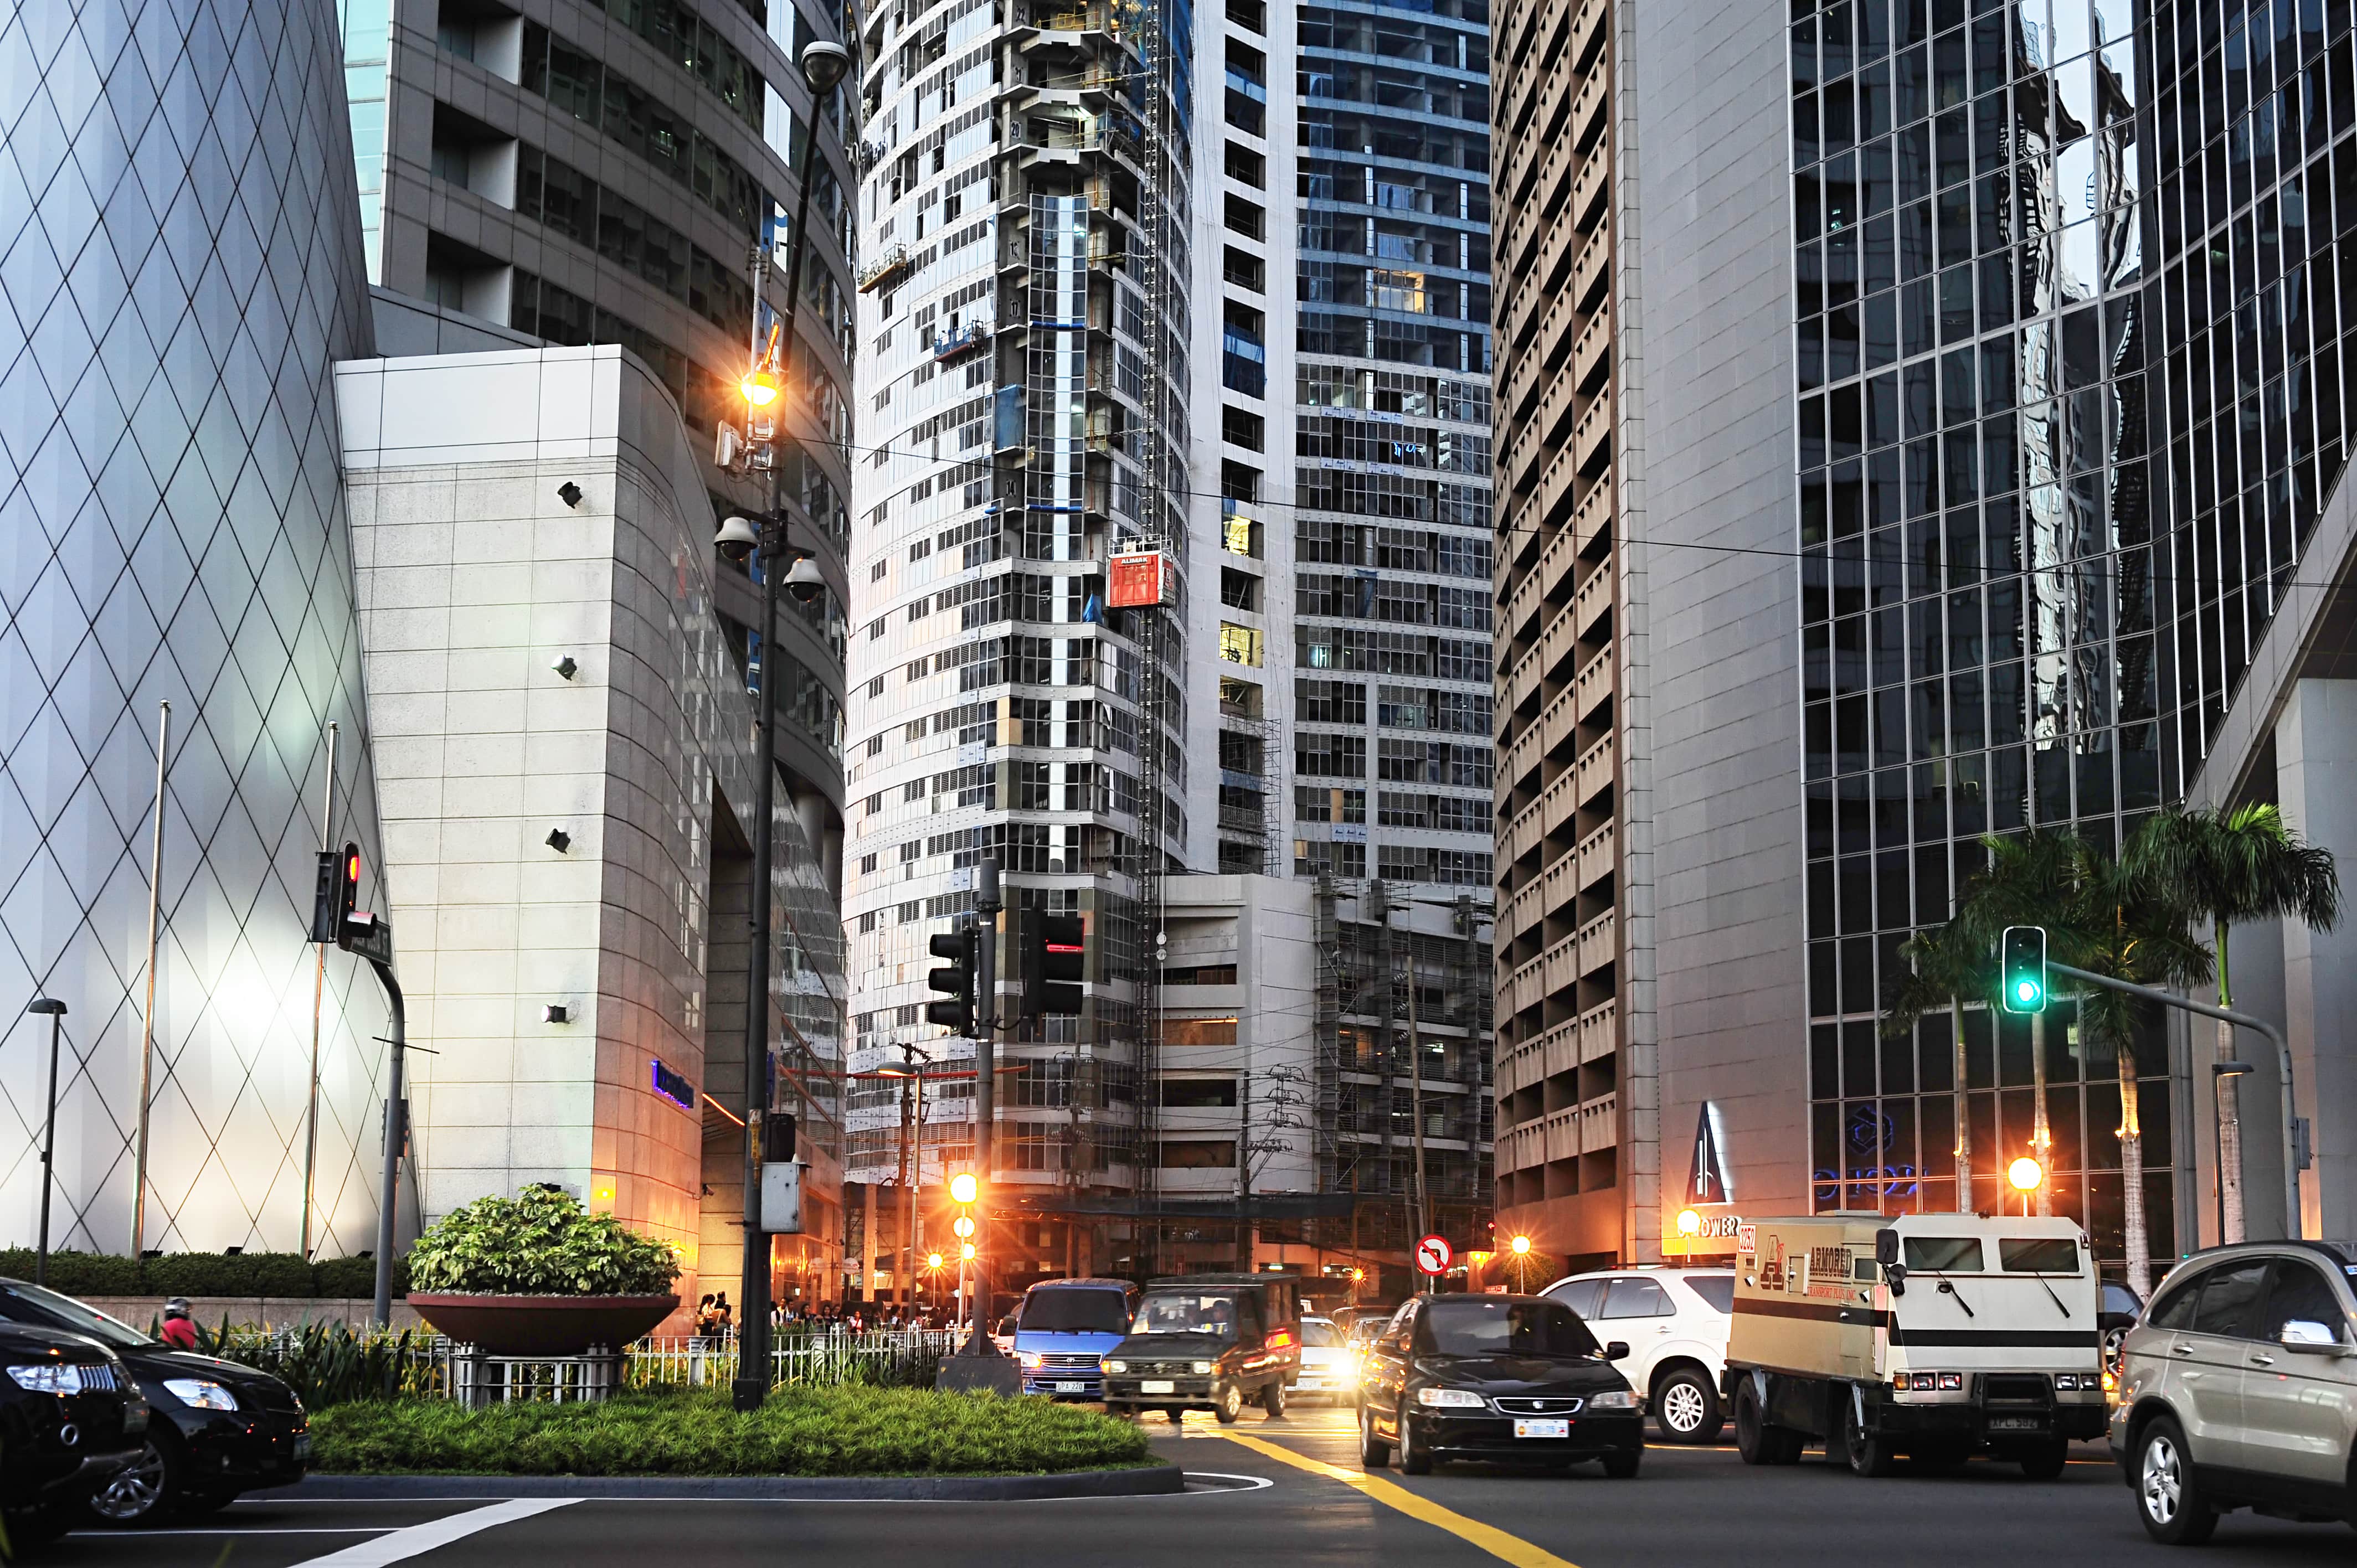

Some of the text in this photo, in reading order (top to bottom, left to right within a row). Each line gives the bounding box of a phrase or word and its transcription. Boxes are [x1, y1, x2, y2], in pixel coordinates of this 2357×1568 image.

[1011, 122, 1020, 137] 20
[1696, 1218, 1738, 1237] OWER
[1740, 1227, 1754, 1250] 3252
[1810, 1247, 1852, 1278] ARMORED
[1808, 1286, 1832, 1298] TRANSPORT
